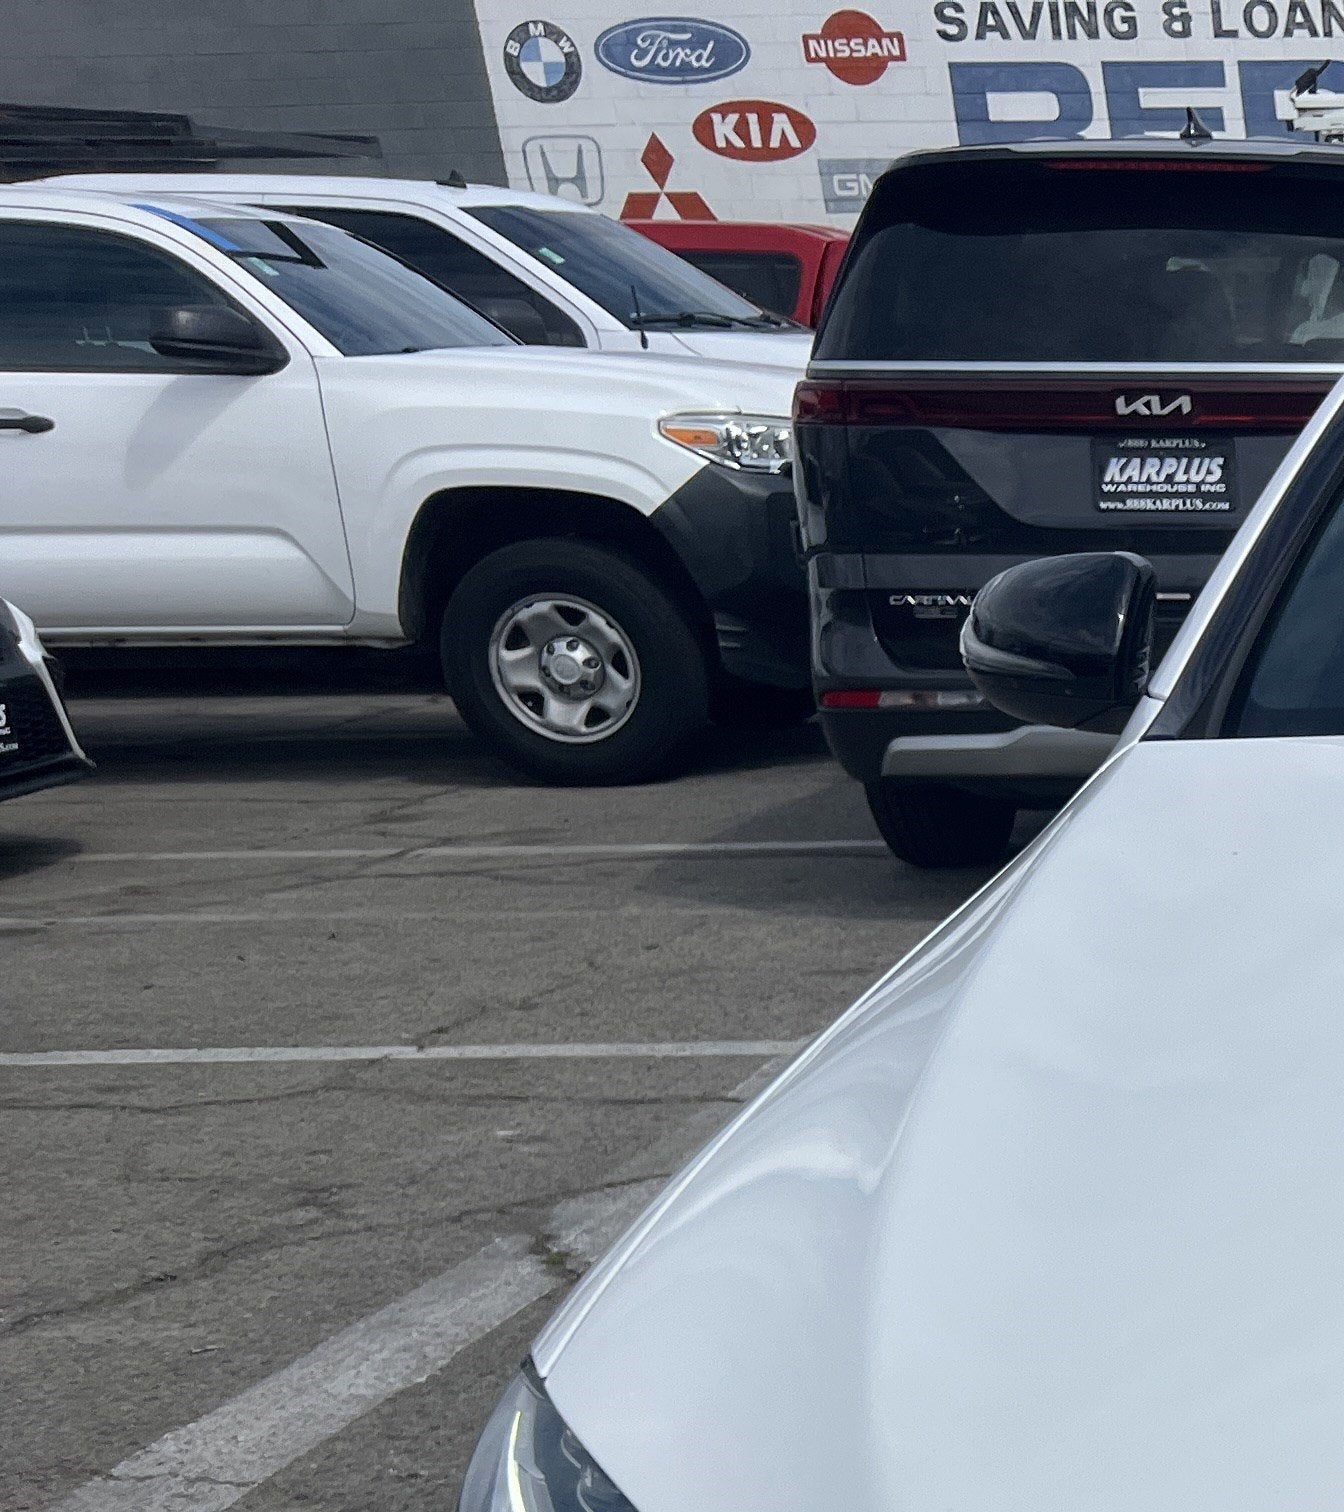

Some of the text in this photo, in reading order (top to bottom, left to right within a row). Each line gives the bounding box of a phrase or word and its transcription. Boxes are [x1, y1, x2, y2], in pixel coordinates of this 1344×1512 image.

[934, 1, 1137, 42] SAVING
[1162, 1, 1193, 39] &
[630, 30, 715, 69] Ford
[808, 37, 902, 59] NISSAN
[709, 112, 802, 149] KIA
[1103, 457, 1225, 483] KARPLUS
[1101, 483, 1227, 493] WAREHOUSE INC
